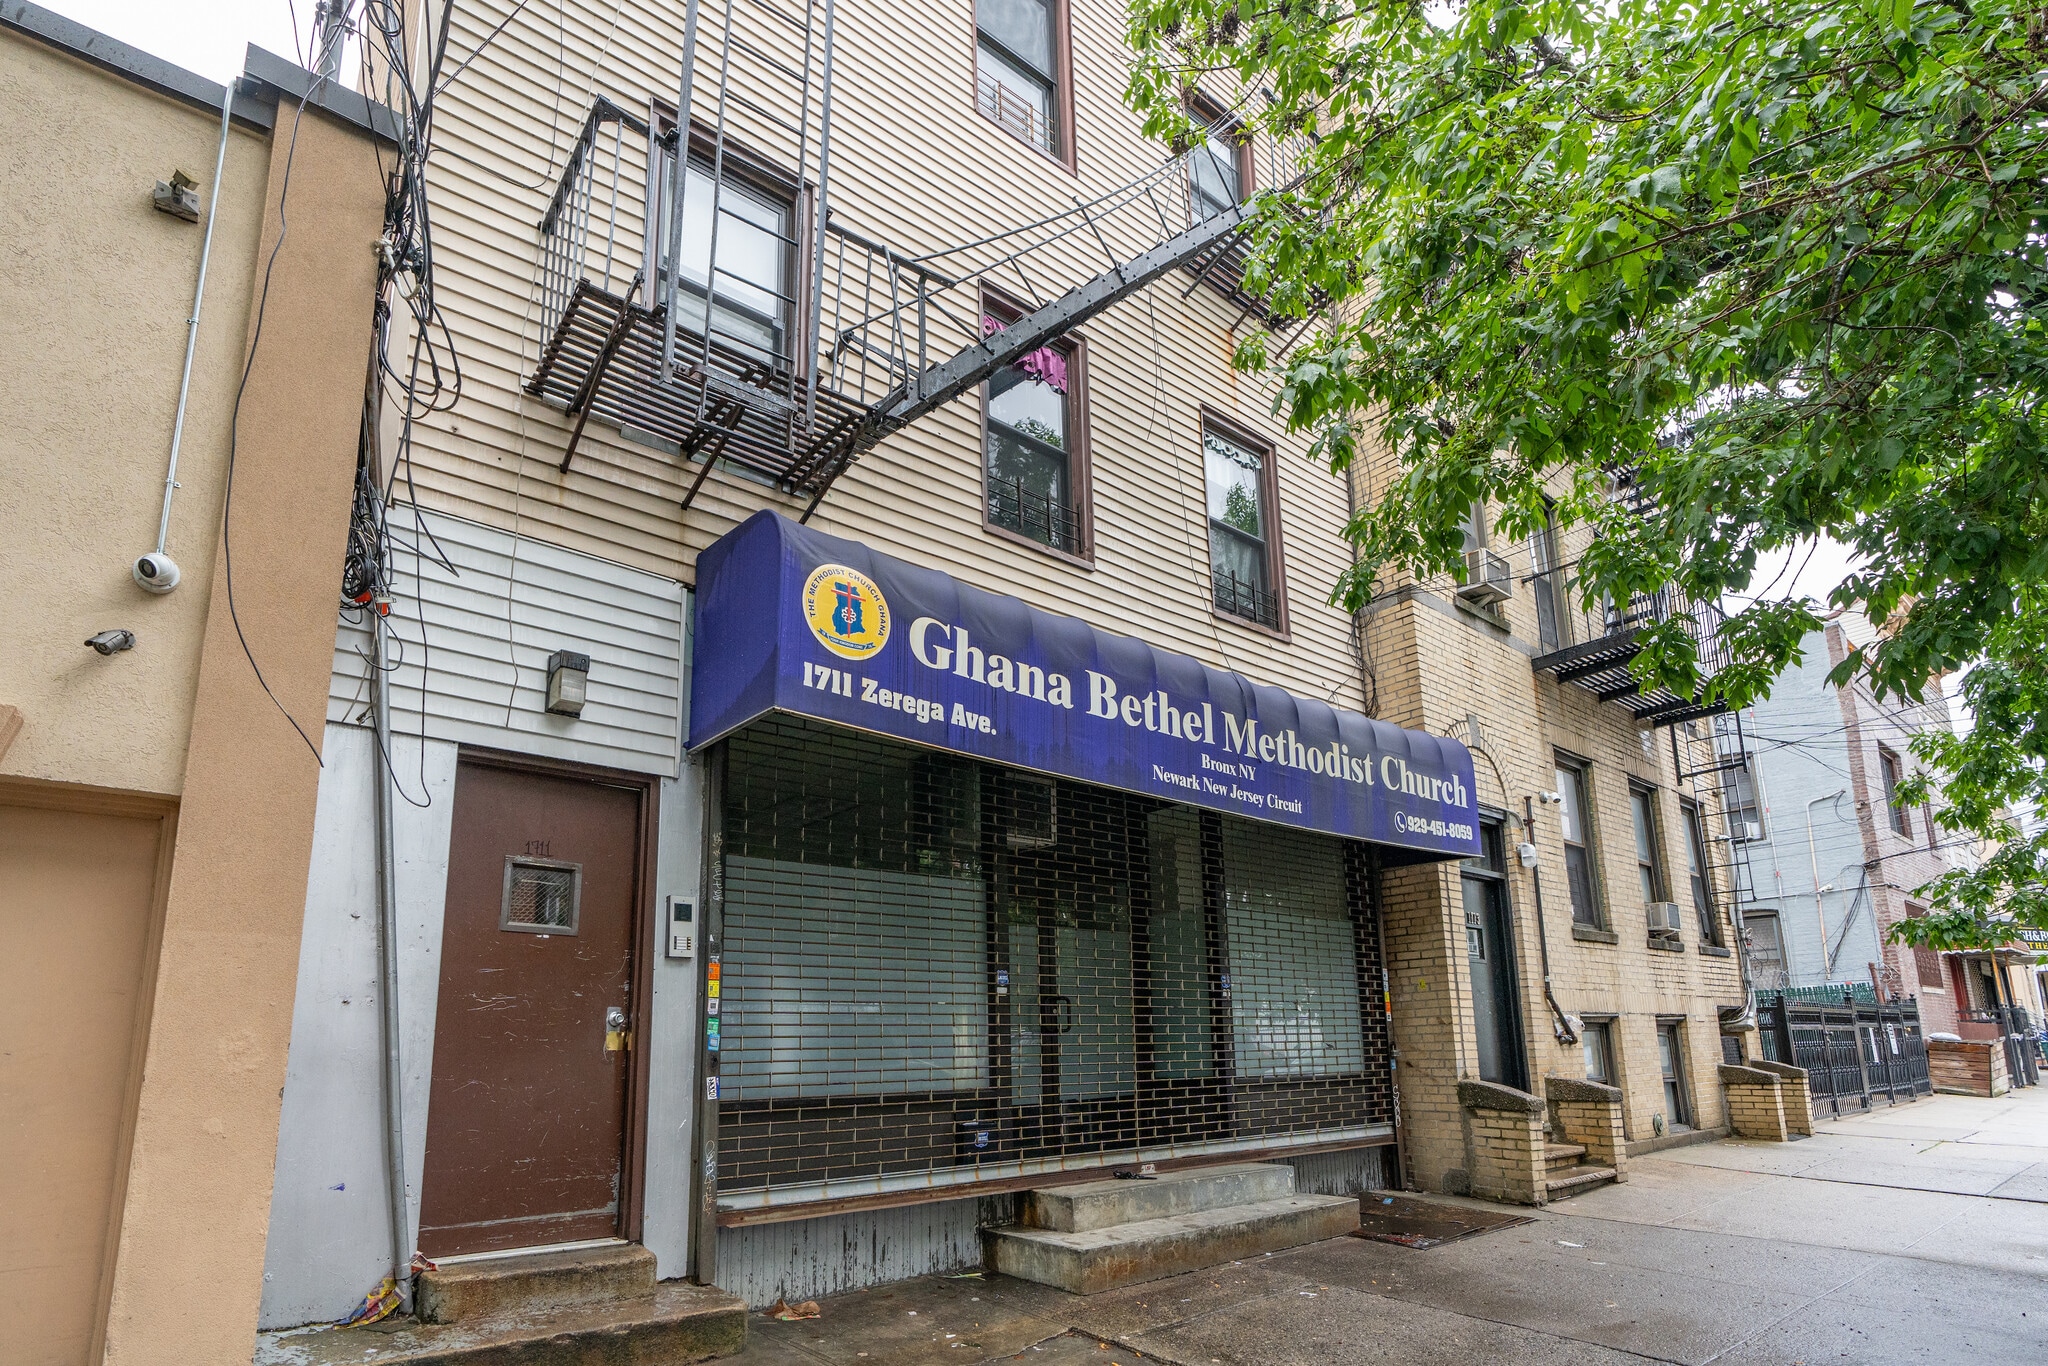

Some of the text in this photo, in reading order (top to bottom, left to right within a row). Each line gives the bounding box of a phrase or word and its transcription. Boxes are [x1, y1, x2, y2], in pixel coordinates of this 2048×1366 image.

[808, 568, 887, 637] THE METHODIST CHURCH GHANA
[803, 661, 997, 736] 1711 Zerega Ave.
[909, 616, 1469, 809] Ghana Bethel Methodist Church
[1152, 764, 1303, 814] Newark New Jersey Circuit
[1201, 752, 1257, 782] Bronx NY
[524, 840, 554, 858] 1711
[1407, 815, 1473, 841] 929-451-8059
